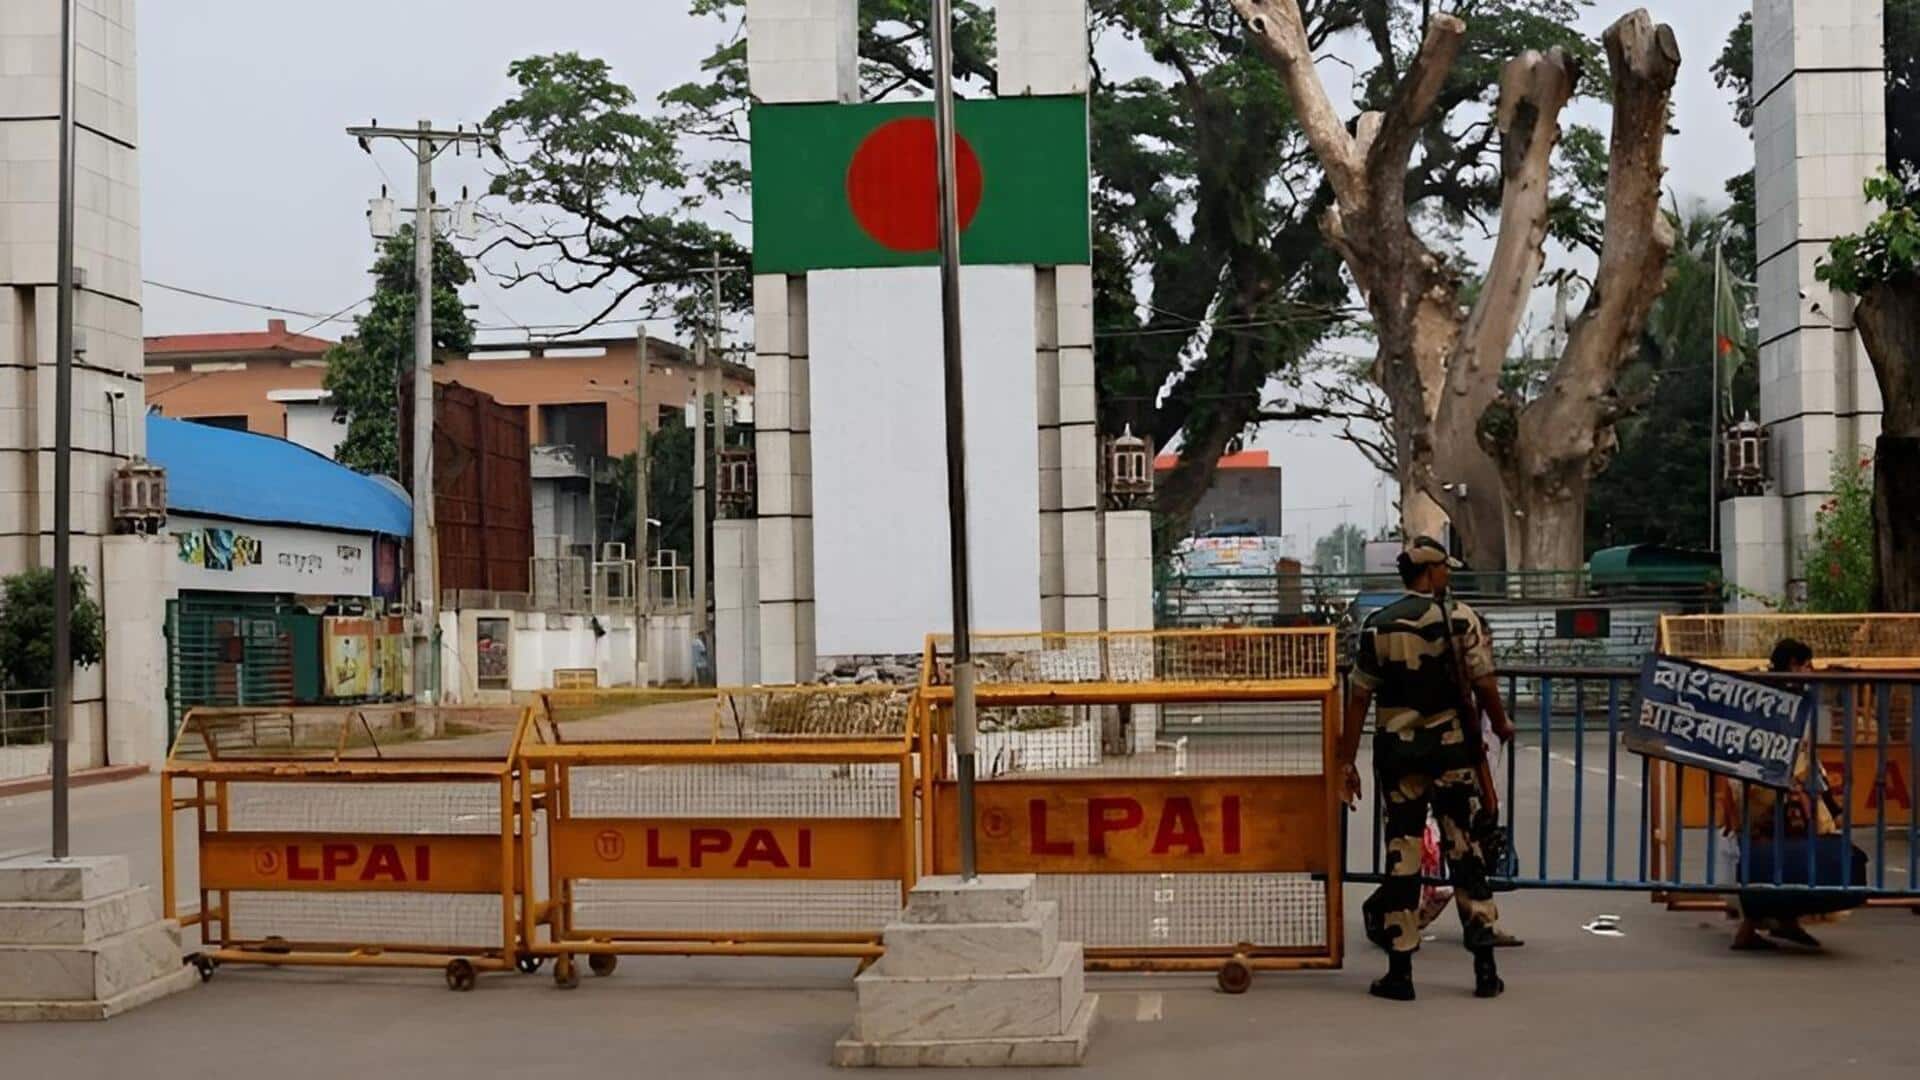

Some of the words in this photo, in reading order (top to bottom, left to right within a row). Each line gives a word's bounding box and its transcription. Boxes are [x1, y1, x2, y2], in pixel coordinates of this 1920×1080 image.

[1653, 659, 1803, 723] বাংলাদেশ
[646, 828, 812, 869] LPAI
[1029, 795, 1242, 857] LPAI
[285, 843, 430, 881] LPAI
